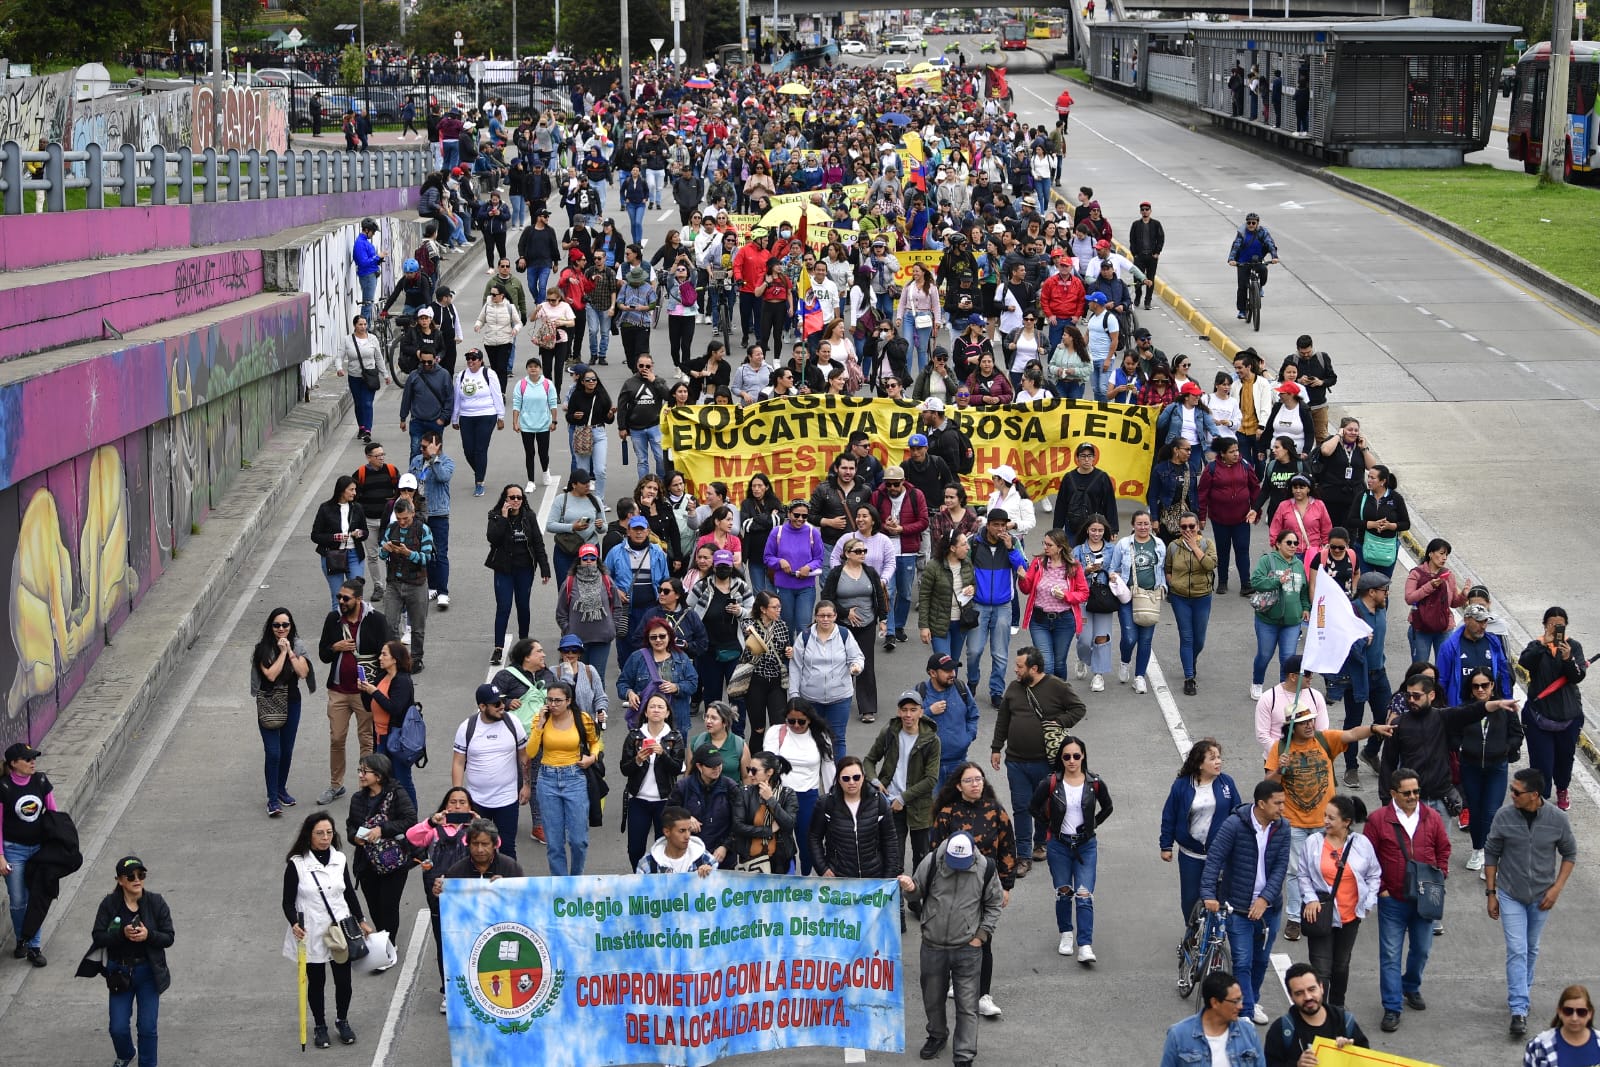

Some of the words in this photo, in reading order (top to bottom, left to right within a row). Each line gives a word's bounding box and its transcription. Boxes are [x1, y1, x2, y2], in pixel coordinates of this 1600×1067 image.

[673, 411, 879, 452] EDUCATIVA
[954, 411, 1046, 443] BOSA
[1060, 413, 1150, 450] I.E.D.
[713, 441, 889, 478] MAESTO
[553, 896, 623, 922] Colegio
[628, 893, 689, 918] Miguel
[694, 893, 716, 912] de
[721, 886, 813, 908] Cervantes
[818, 885, 893, 908] Saavedr
[493, 925, 529, 936] EDUCATIVA
[595, 928, 693, 951] Institución
[699, 919, 784, 948] Educativa
[790, 917, 862, 941] Distrital
[576, 969, 722, 1008] COMPROMETIDO
[725, 961, 761, 997] CON
[765, 960, 787, 992] LA
[791, 949, 894, 992] EDUCACIÓN
[474, 985, 488, 1007] MIGUEL
[496, 1005, 530, 1016] CERVANTES
[625, 1012, 649, 1045] DE
[653, 1014, 676, 1046] LA
[680, 1000, 774, 1048] LOCALIDAD
[777, 996, 850, 1028] QUINTA.
